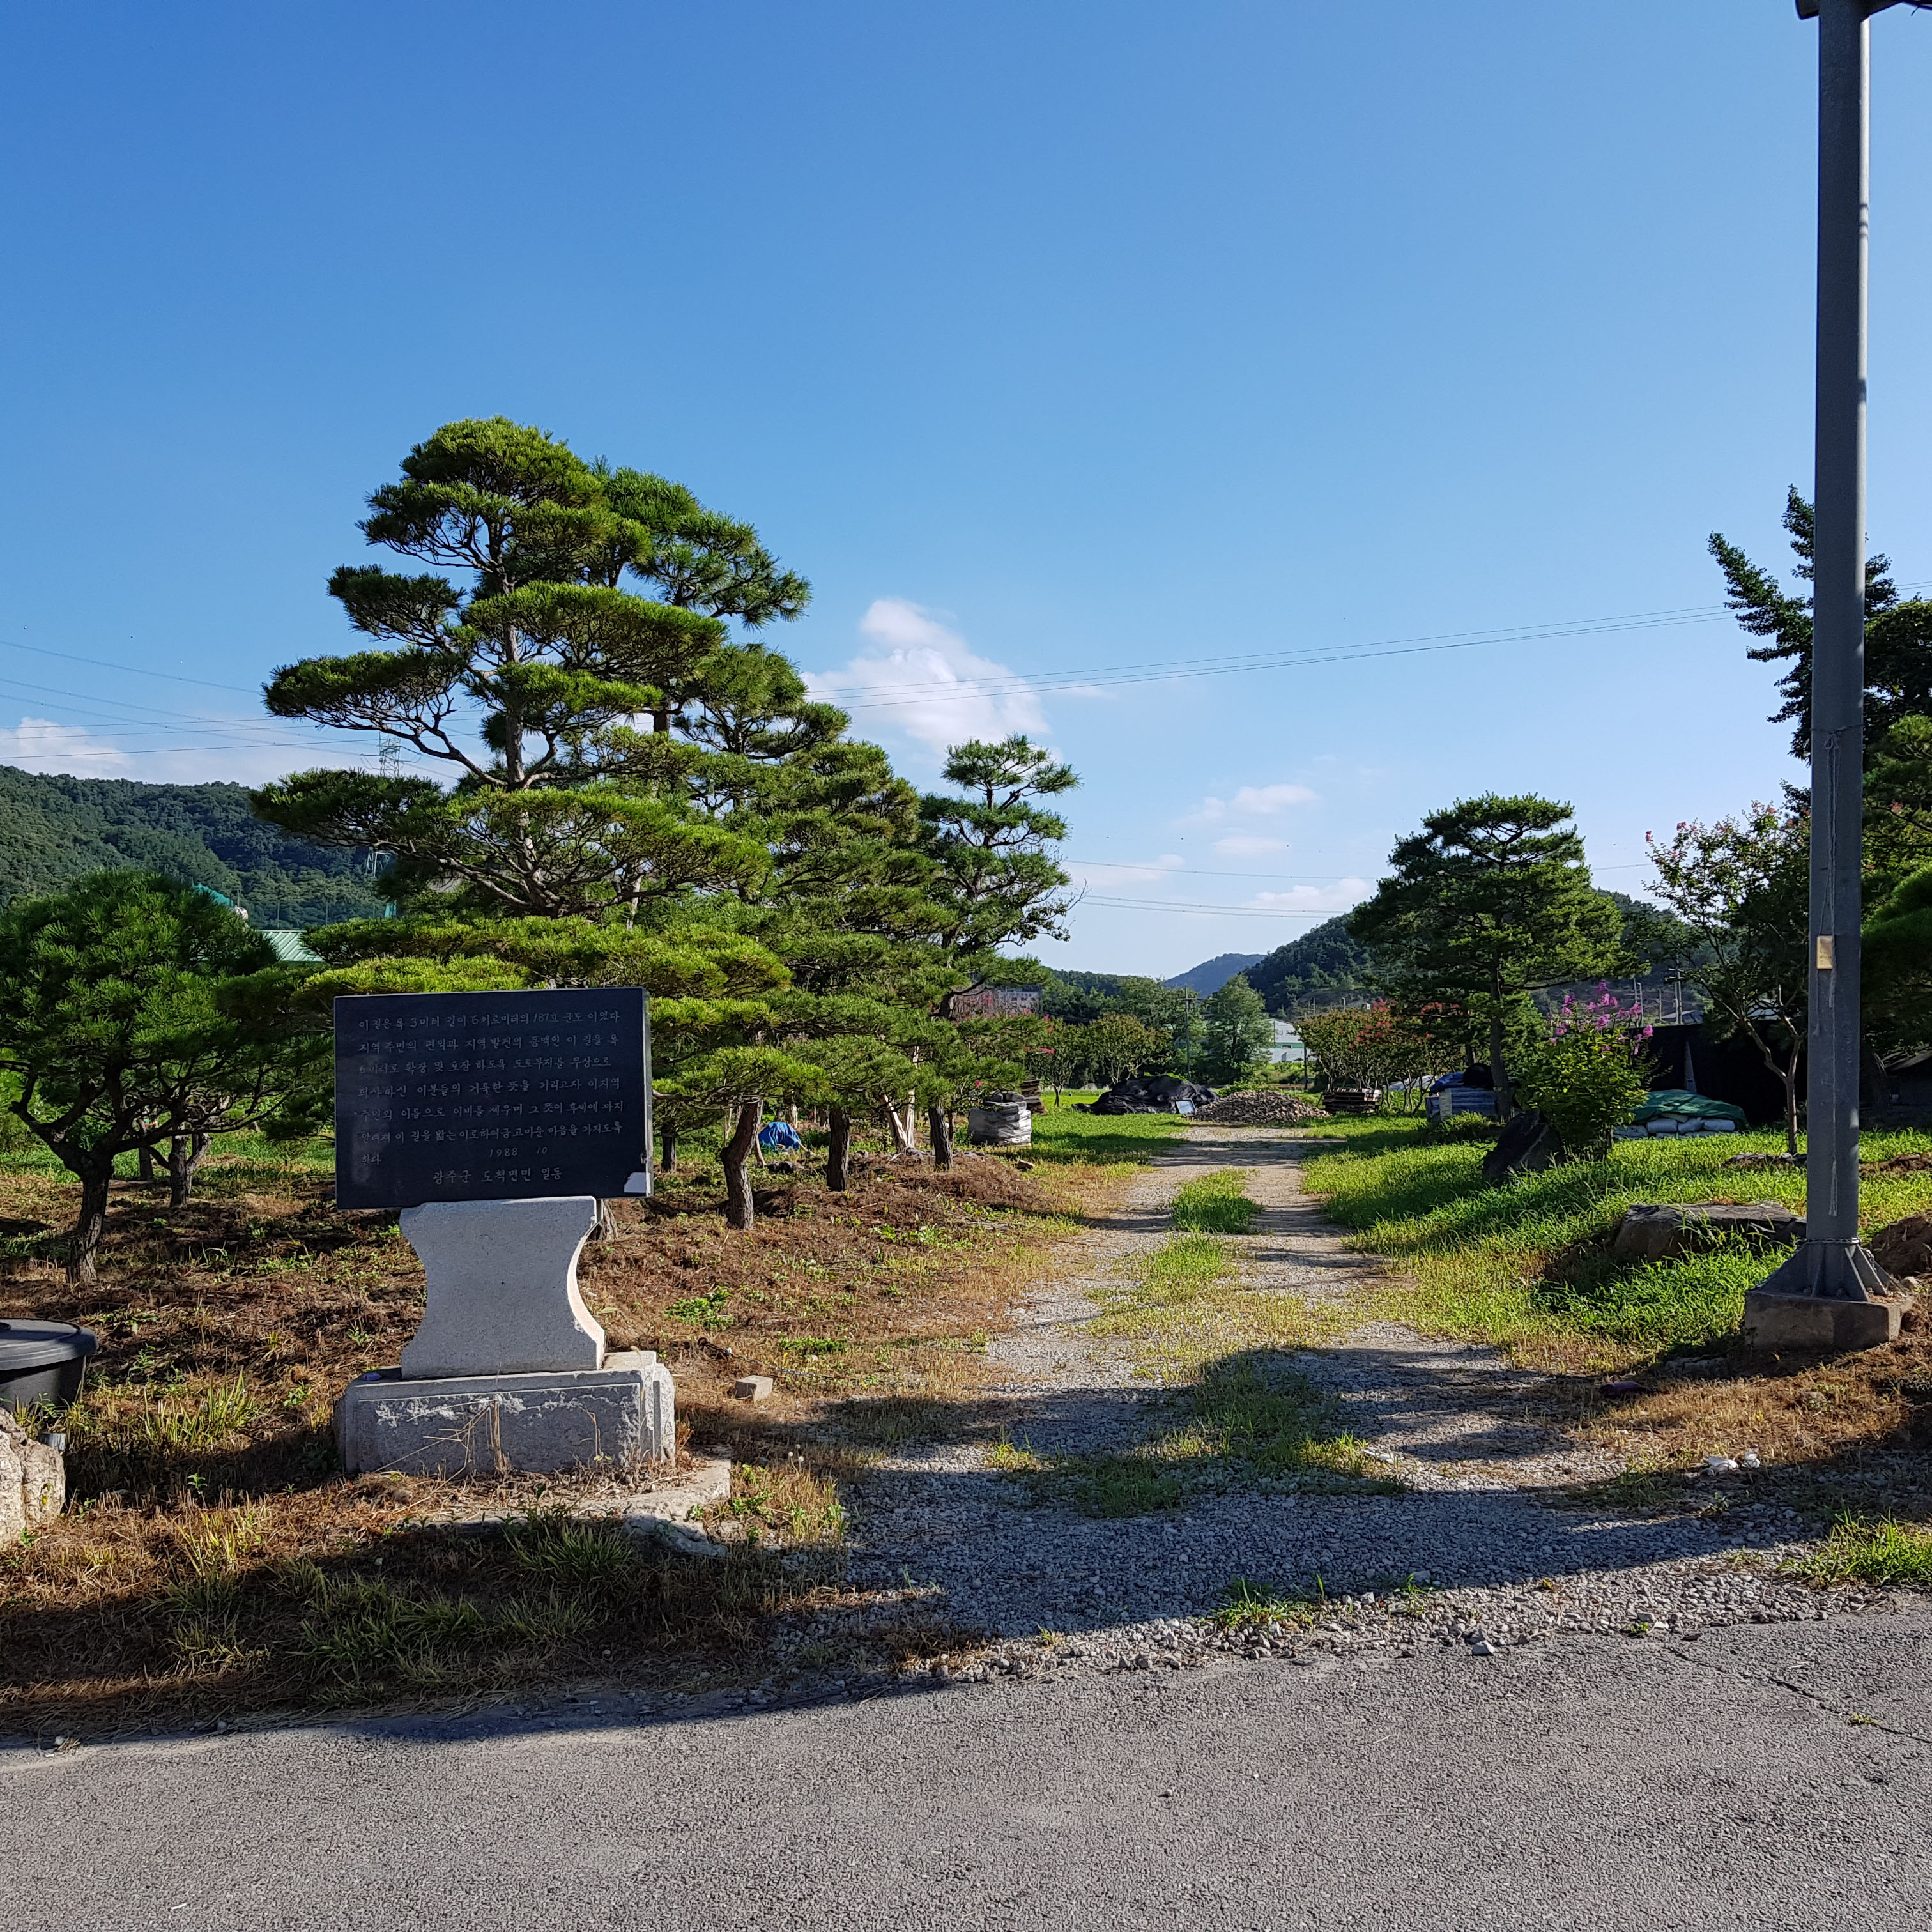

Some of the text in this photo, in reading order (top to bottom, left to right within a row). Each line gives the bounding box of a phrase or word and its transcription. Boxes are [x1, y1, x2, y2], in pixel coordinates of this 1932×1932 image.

[359, 1020, 369, 1031] 이
[373, 1018, 392, 1029] 길은
[410, 1016, 440, 1027] 3미터
[447, 1015, 466, 1027] 길이
[563, 1013, 583, 1022] 군도
[588, 1011, 620, 1023] 이었다
[358, 1042, 380, 1054] 지역
[385, 1040, 417, 1053] 주민의
[425, 1038, 459, 1050] 편익과
[466, 1038, 486, 1050] 지역
[491, 1037, 522, 1049] 발전의
[530, 1035, 560, 1047] 동맥인
[567, 1035, 576, 1046] 이
[583, 1034, 602, 1046] 길을
[405, 1062, 427, 1075] 확장
[434, 1061, 443, 1072] 및
[448, 1060, 471, 1071] 포장
[476, 1059, 506, 1070] 하도록
[514, 1057, 564, 1070] 도로부지를
[571, 1057, 611, 1069] 무상으로
[358, 1078, 620, 1099] 희사하신 이분들의 거룩한 뜻을 기리고자 이지역
[361, 1109, 392, 1121] 주민의
[401, 1108, 445, 1120] 이름으로
[454, 1105, 484, 1117] 이비를
[490, 1104, 522, 1116] 세우며
[543, 1102, 562, 1113] 뜻이
[566, 1101, 598, 1114] 후세에
[602, 1101, 624, 1112] 까지
[395, 1131, 404, 1143] 이
[411, 1130, 431, 1142] 길을
[548, 1124, 578, 1137] 마음을
[583, 1121, 622, 1135] 가지도록
[362, 1154, 381, 1165] 한다
[490, 1149, 518, 1158] 1988
[433, 1167, 562, 1184] 광주군 도척면민 일동
